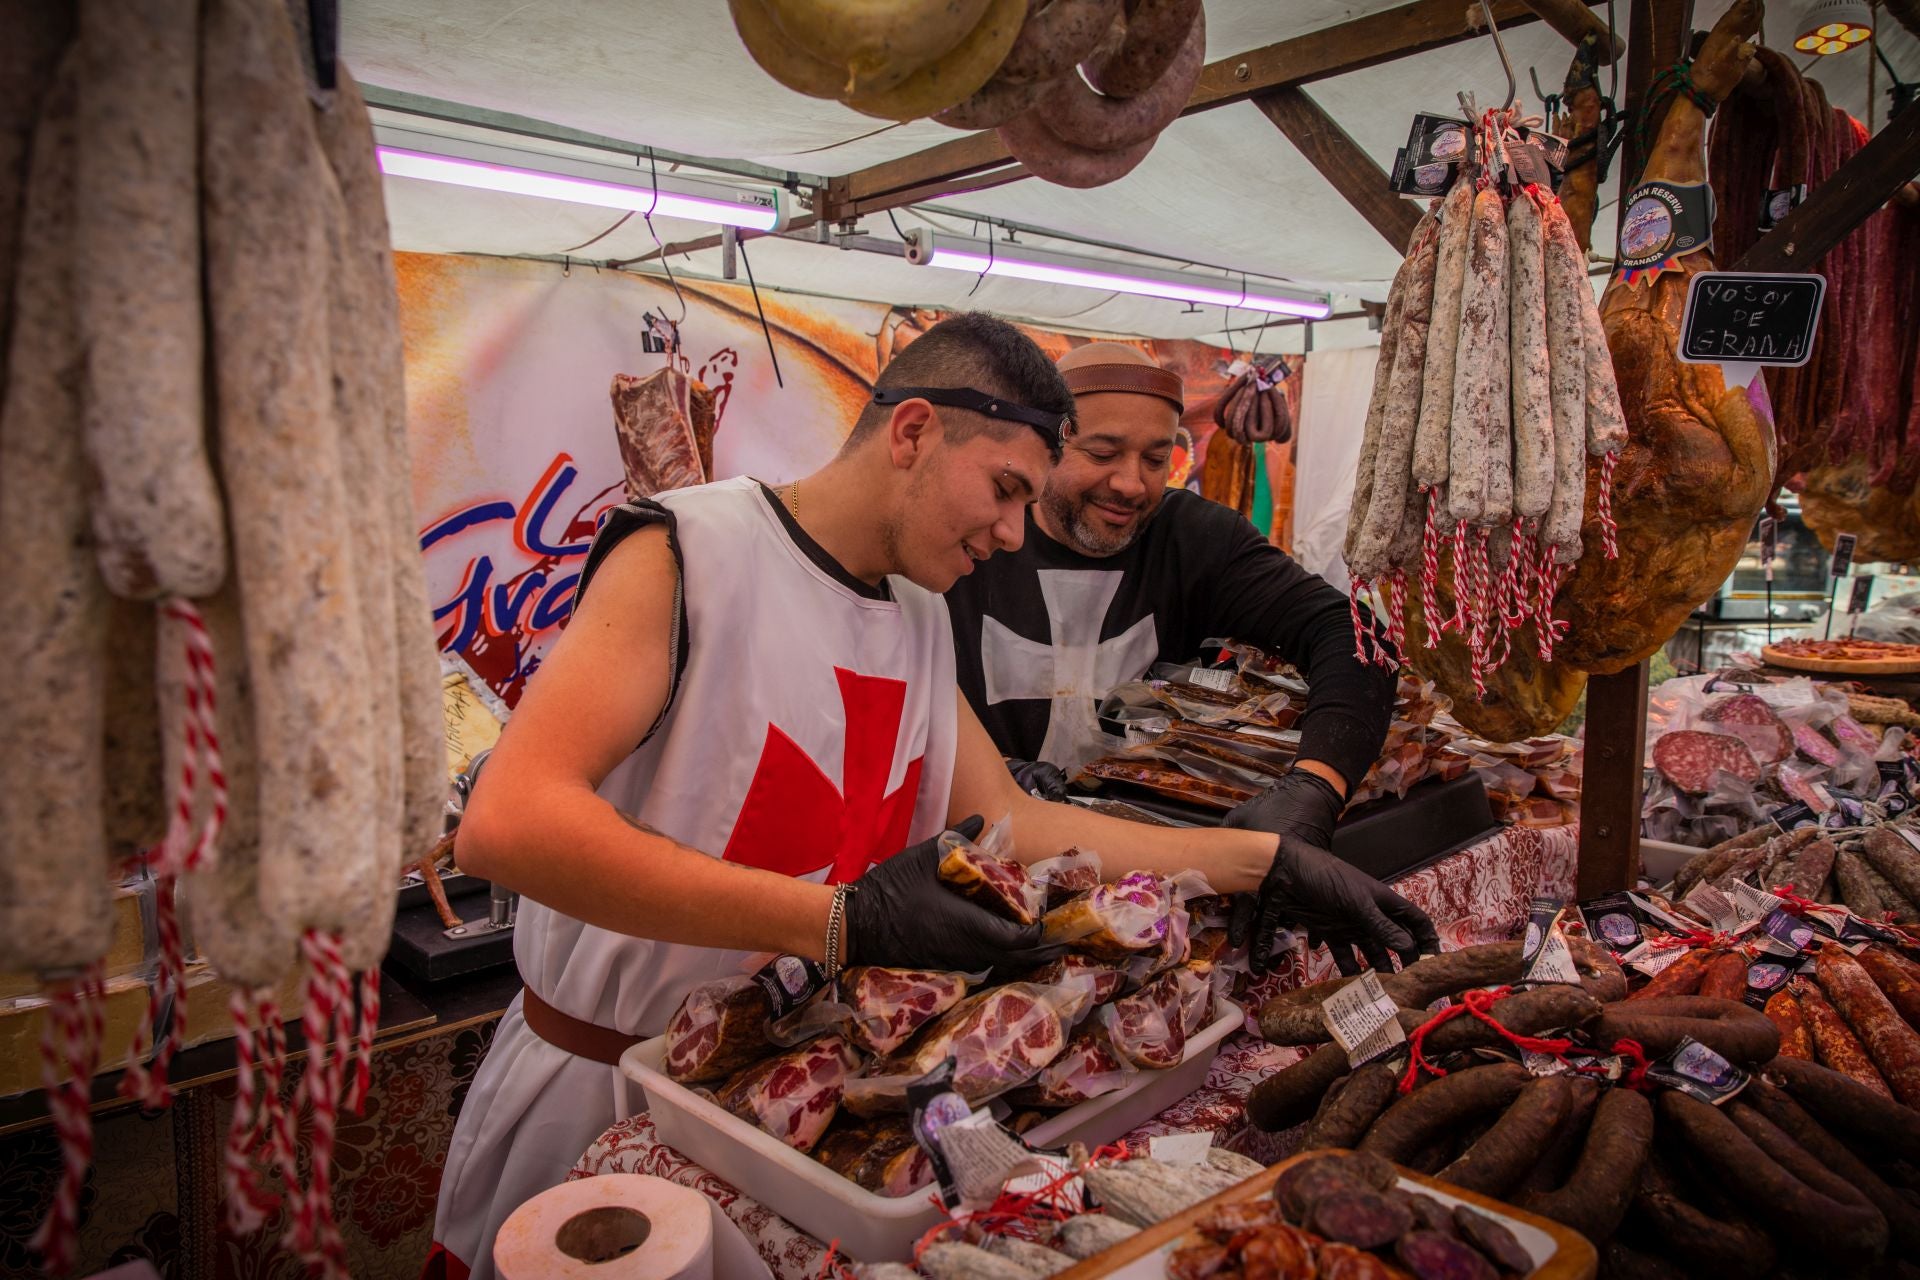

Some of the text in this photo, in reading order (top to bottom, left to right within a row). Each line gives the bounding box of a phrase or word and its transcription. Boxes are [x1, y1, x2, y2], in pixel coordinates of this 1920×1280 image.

[1628, 187, 1684, 216] GRAN RESERVA
[1623, 252, 1664, 266] GRANADA
[1733, 308, 1766, 328] DE
